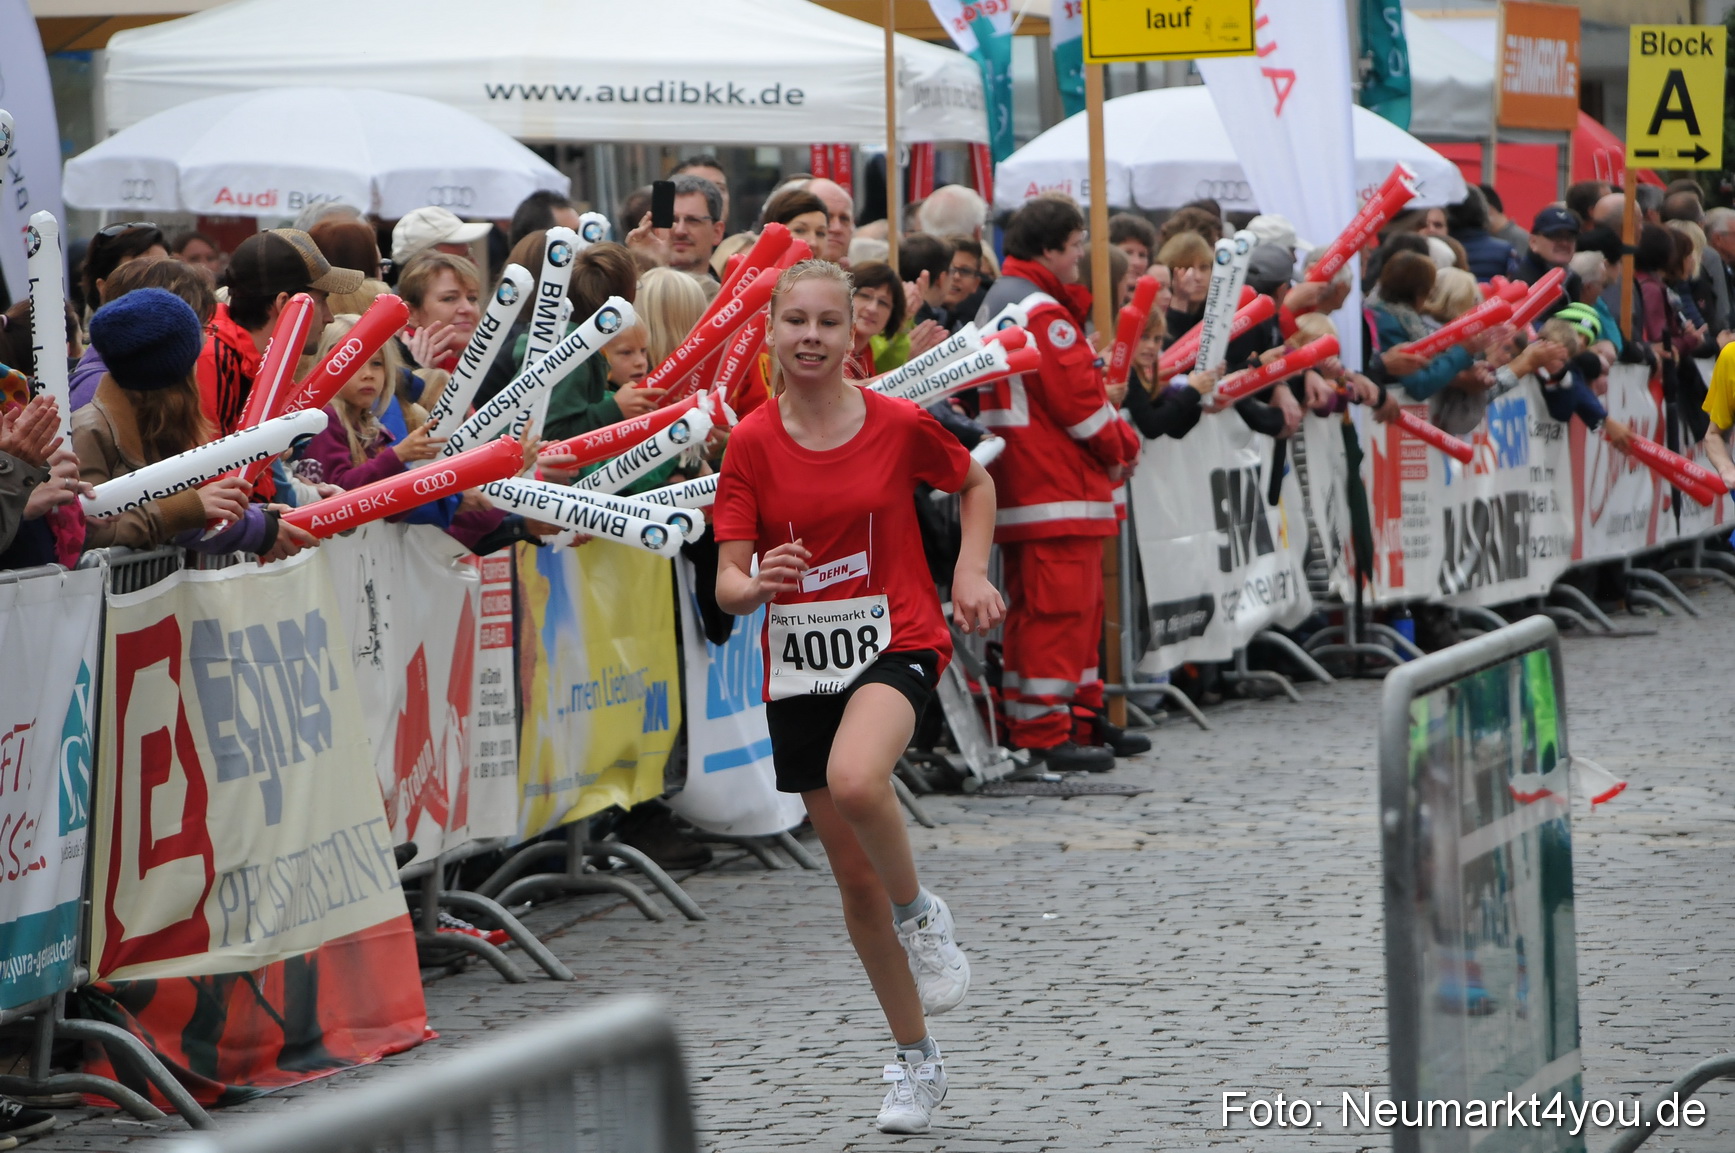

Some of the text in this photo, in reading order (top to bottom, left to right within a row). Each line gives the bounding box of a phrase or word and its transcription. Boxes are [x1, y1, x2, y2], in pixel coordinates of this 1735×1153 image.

[1145, 7, 1192, 29] lauf
[1640, 31, 1714, 56] Block
[485, 80, 806, 105] www.audibkk.de
[1646, 68, 1702, 136] A
[214, 186, 278, 208] Audi
[531, 280, 563, 341] BMW
[464, 312, 501, 370] BMW
[737, 323, 758, 355] BKK
[646, 331, 705, 389] Audi BKK
[583, 417, 650, 450] Audi BKK
[616, 436, 663, 479] BMW
[310, 488, 399, 530] Audi BKK
[565, 504, 629, 539] BMW
[819, 563, 849, 583] DEHN
[770, 610, 867, 627] PARTL Neumarkt
[782, 624, 879, 671] 4008
